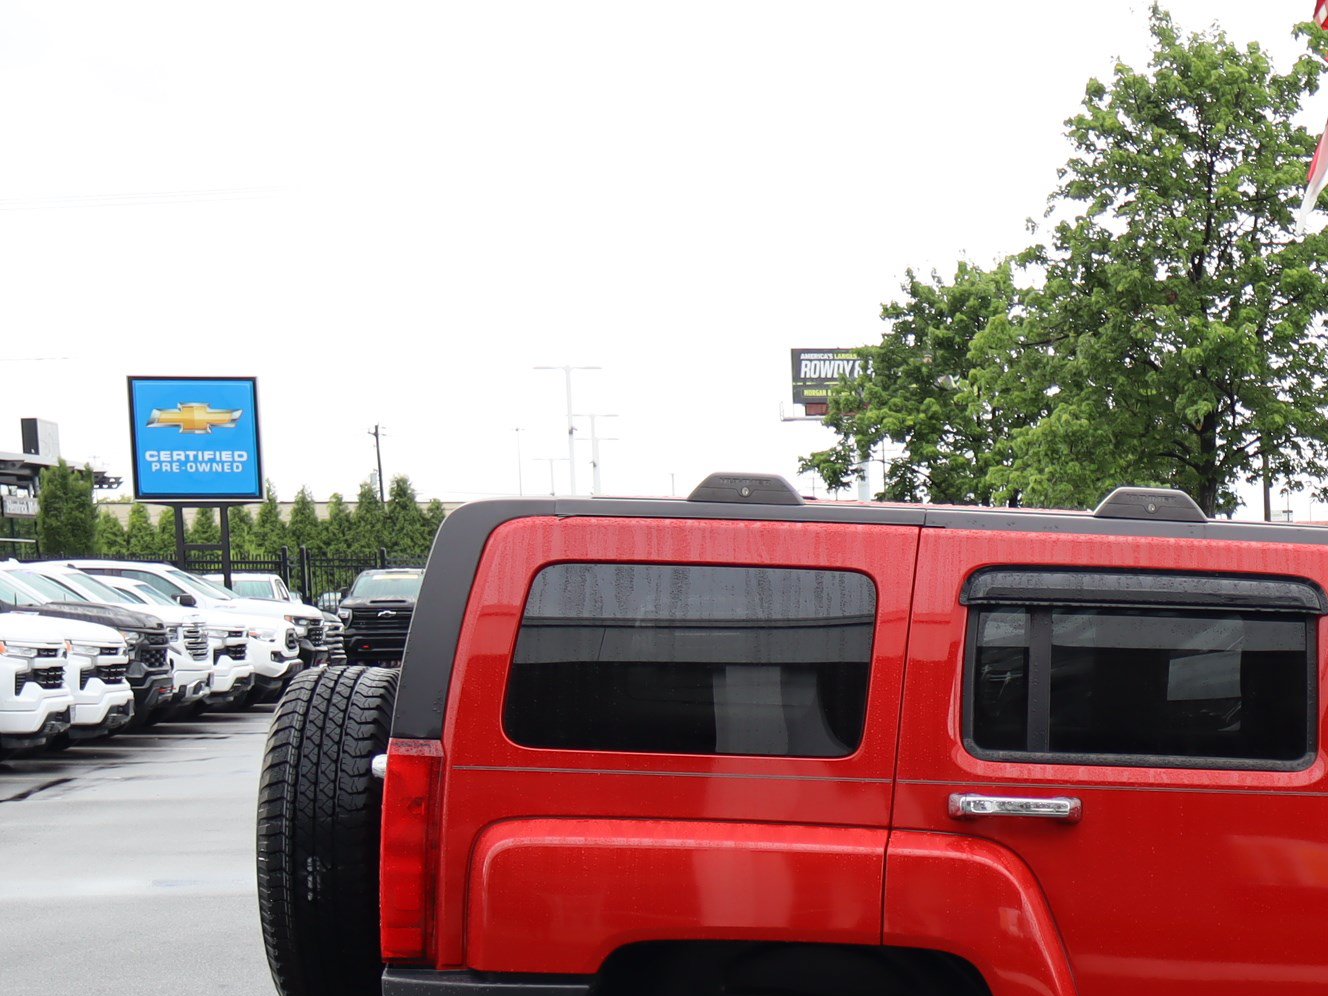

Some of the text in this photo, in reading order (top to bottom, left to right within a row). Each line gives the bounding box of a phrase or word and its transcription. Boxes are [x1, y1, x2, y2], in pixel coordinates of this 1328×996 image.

[800, 360, 853, 378] ROWDY
[144, 450, 249, 462] CERTIFIED
[151, 462, 243, 472] PRE-OWNED
